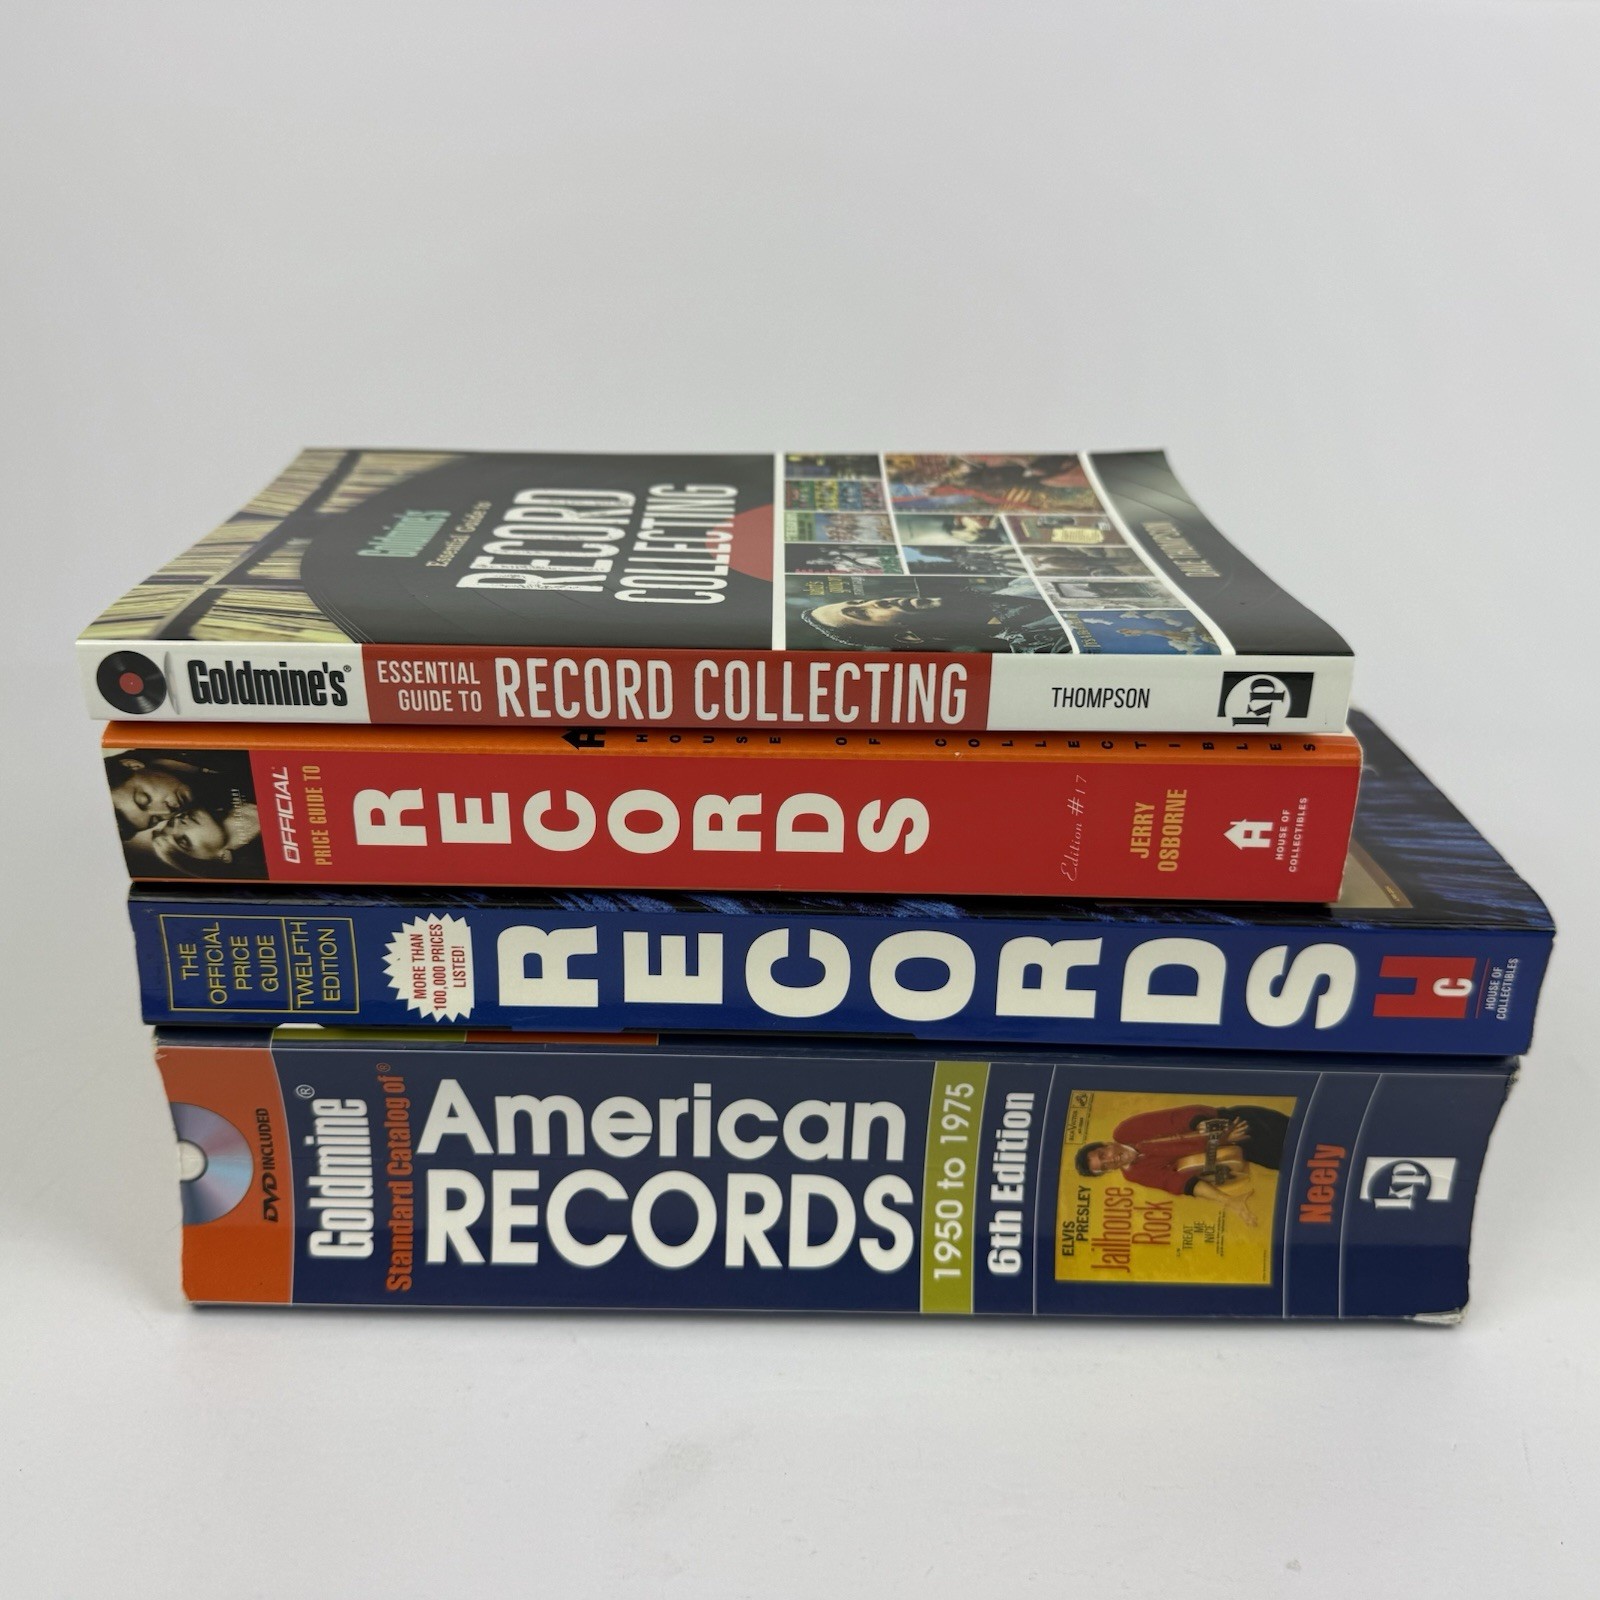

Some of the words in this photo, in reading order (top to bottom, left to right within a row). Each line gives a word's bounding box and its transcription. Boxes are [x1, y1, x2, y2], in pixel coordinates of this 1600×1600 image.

[456, 488, 636, 592] RECORD
[614, 484, 738, 604] COLLECTING
[377, 660, 480, 685] ESSENTIAL
[398, 689, 453, 712] GUIDE
[458, 690, 482, 712] TO
[496, 657, 674, 721] RECORD
[694, 661, 967, 724] COLLECTING
[1051, 687, 1150, 709] THOMPSON
[636, 733, 782, 745] HOUSE
[835, 737, 881, 746] OF
[935, 738, 1316, 753] COLLECTIBLES
[302, 765, 321, 781] TO
[272, 766, 301, 864] OFFICIAL
[305, 787, 327, 824] GUIDE
[353, 788, 930, 856] RECORDS
[1130, 802, 1155, 859] JERRY
[1157, 789, 1187, 872] OSBORNE
[1281, 808, 1291, 823] OF
[310, 830, 333, 866] PRICE
[1060, 821, 1082, 882] Edition
[1275, 825, 1288, 861] HOUSE
[1288, 797, 1308, 873] COLLECTIBLES
[179, 943, 198, 980] THE
[203, 922, 228, 1004] OFFICIAL
[230, 935, 252, 990] PRICE
[256, 934, 280, 992] GUIDE
[290, 921, 315, 1008] TWELFTH
[318, 928, 341, 1001] EDITION
[410, 933, 424, 963] THAN
[430, 923, 445, 962] PRICES
[452, 945, 467, 988] LISTED!
[413, 969, 428, 999] MORE
[433, 965, 447, 1010] 100,000
[497, 924, 1356, 1030] RECORDS
[1485, 979, 1499, 1010] HOUSE
[1492, 966, 1502, 979] OF
[1496, 957, 1519, 1020] COLLECTIBLES
[255, 1108, 275, 1170] INCLUDED
[384, 1097, 413, 1176] Catalog
[417, 1078, 907, 1162] American
[940, 1083, 975, 1144] 1975
[936, 1157, 966, 1190] to
[990, 1092, 1035, 1201] Edition
[261, 1172, 280, 1223] DVD
[1299, 1143, 1346, 1223] Neely
[386, 1180, 414, 1291] Standard
[425, 1168, 915, 1272] RECORDS
[933, 1199, 963, 1280] 1950
[1062, 1221, 1075, 1257] ELVIS
[1076, 1185, 1091, 1242] PRESLEY
[1091, 1186, 1134, 1273] Jailhouse
[1132, 1200, 1173, 1245] Rock
[1182, 1223, 1194, 1250] TREAT
[1194, 1221, 1205, 1234] ME
[1204, 1223, 1215, 1244] NICE
[987, 1209, 1023, 1276] 6th
